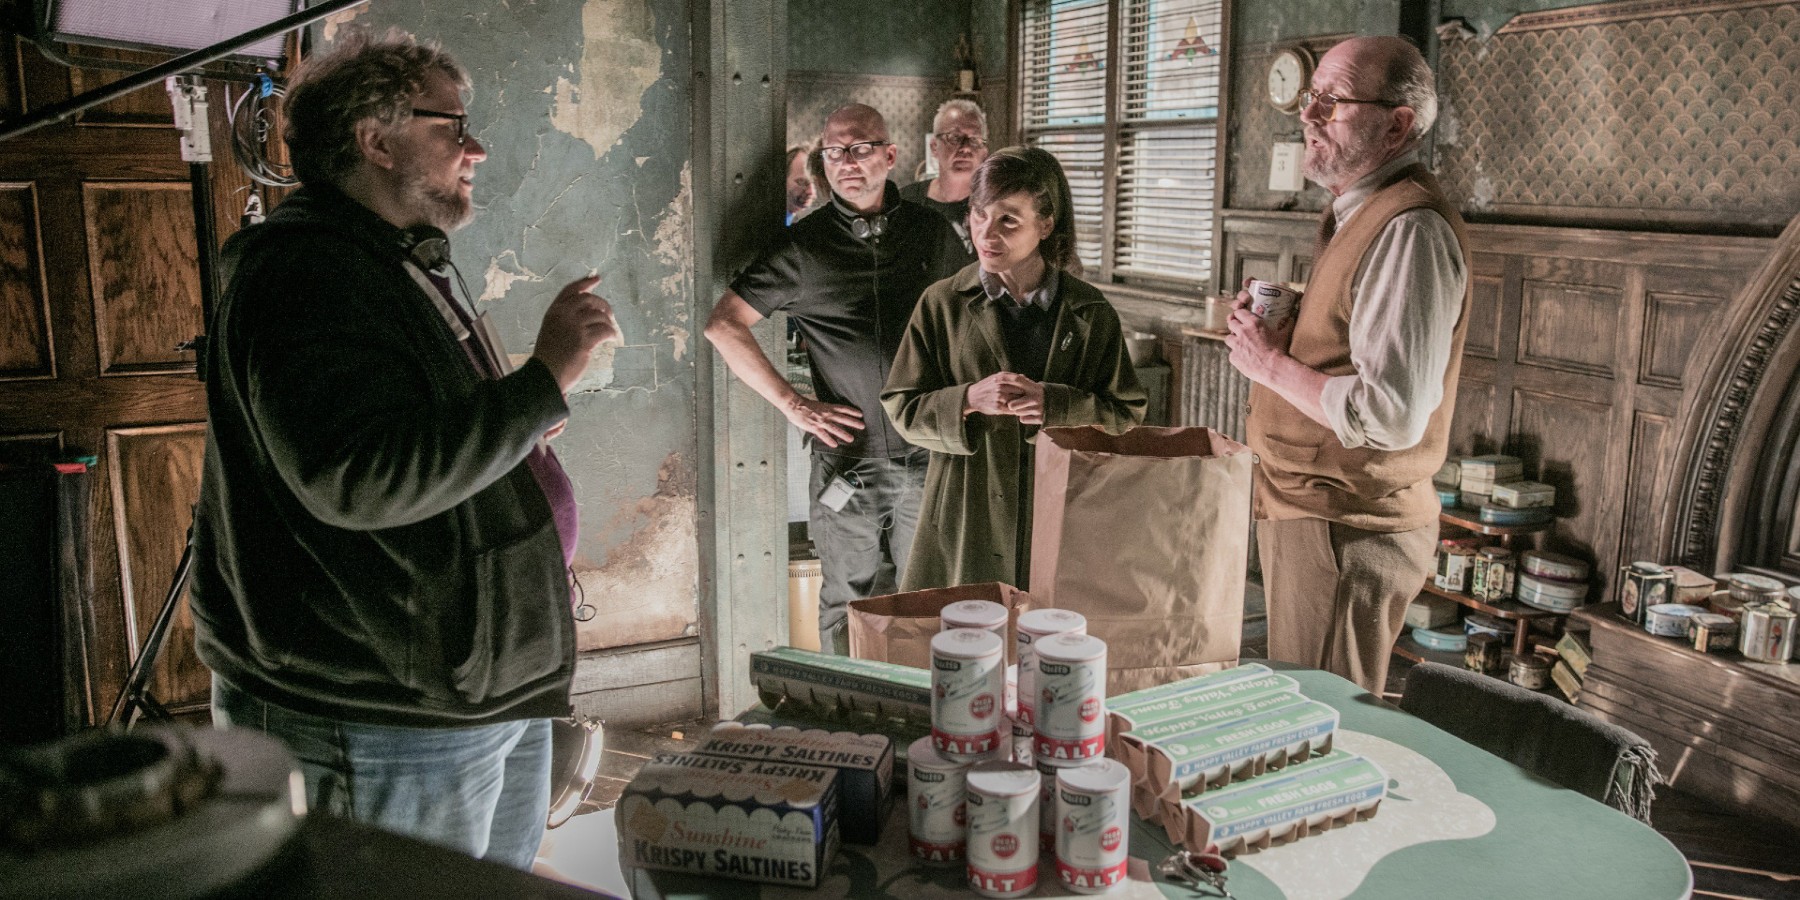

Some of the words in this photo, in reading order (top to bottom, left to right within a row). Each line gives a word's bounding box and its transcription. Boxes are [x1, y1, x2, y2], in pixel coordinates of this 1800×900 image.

[1215, 726, 1257, 745] FRESH
[1254, 719, 1290, 734] EGGS
[704, 739, 776, 756] KRISPY
[780, 745, 875, 766] SALTINES
[935, 737, 991, 754] SALT
[1041, 742, 1098, 759] SALT
[1194, 756, 1220, 770] HAPPY
[1222, 748, 1250, 762] VALLEY
[1250, 741, 1271, 753] FARM
[1272, 733, 1297, 747] FRESH
[1298, 726, 1319, 739] EGGS
[652, 752, 747, 774] SALTINES
[753, 764, 826, 782] KRISPY
[1258, 790, 1298, 807] FRESH
[1302, 780, 1337, 796] EGGS
[1234, 819, 1261, 833] HAPPY
[1263, 810, 1292, 825] VALLEY
[1294, 804, 1315, 817] FARM
[1317, 797, 1344, 811] FRESH
[1345, 791, 1367, 803] EGGS
[673, 821, 767, 849] Sunshine
[634, 839, 705, 869] KRISPY
[714, 849, 812, 881] SALTINES
[917, 846, 957, 861] SAL
[1061, 870, 1120, 887] SALT
